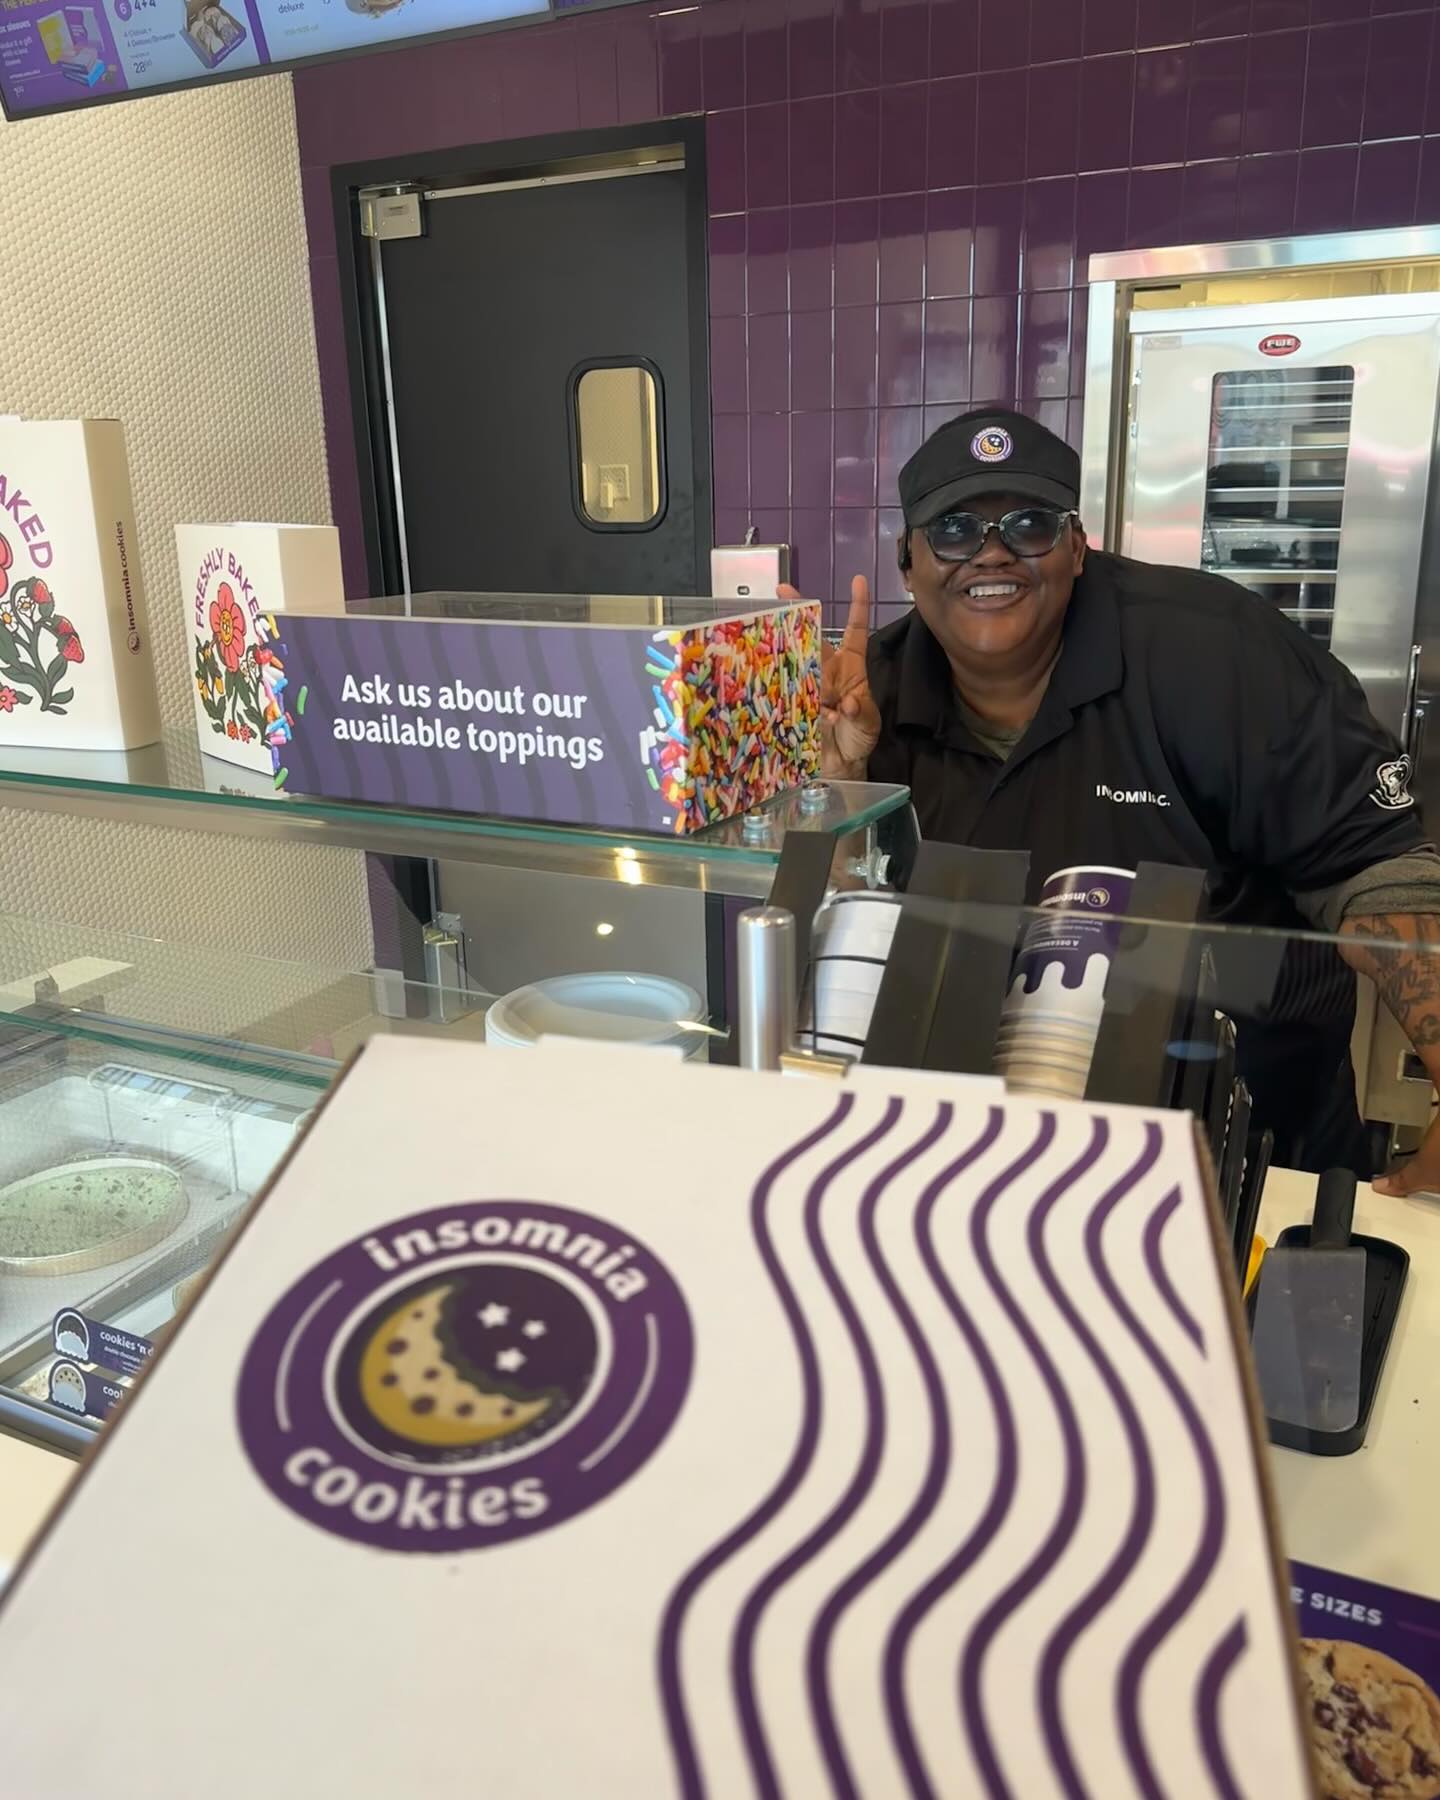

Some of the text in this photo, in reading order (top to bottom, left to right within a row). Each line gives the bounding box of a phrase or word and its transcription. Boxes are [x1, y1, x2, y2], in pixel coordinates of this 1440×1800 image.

[116, 521, 137, 631] insomnia cookies
[195, 547, 224, 629] FRESHLY
[341, 674, 588, 719] Ask us about our
[333, 714, 604, 769] available toppings
[362, 1215, 649, 1302] insomnia
[100, 1330, 136, 1350] cookies
[283, 1447, 550, 1531] cookies
[1310, 1592, 1383, 1626] SIZES
